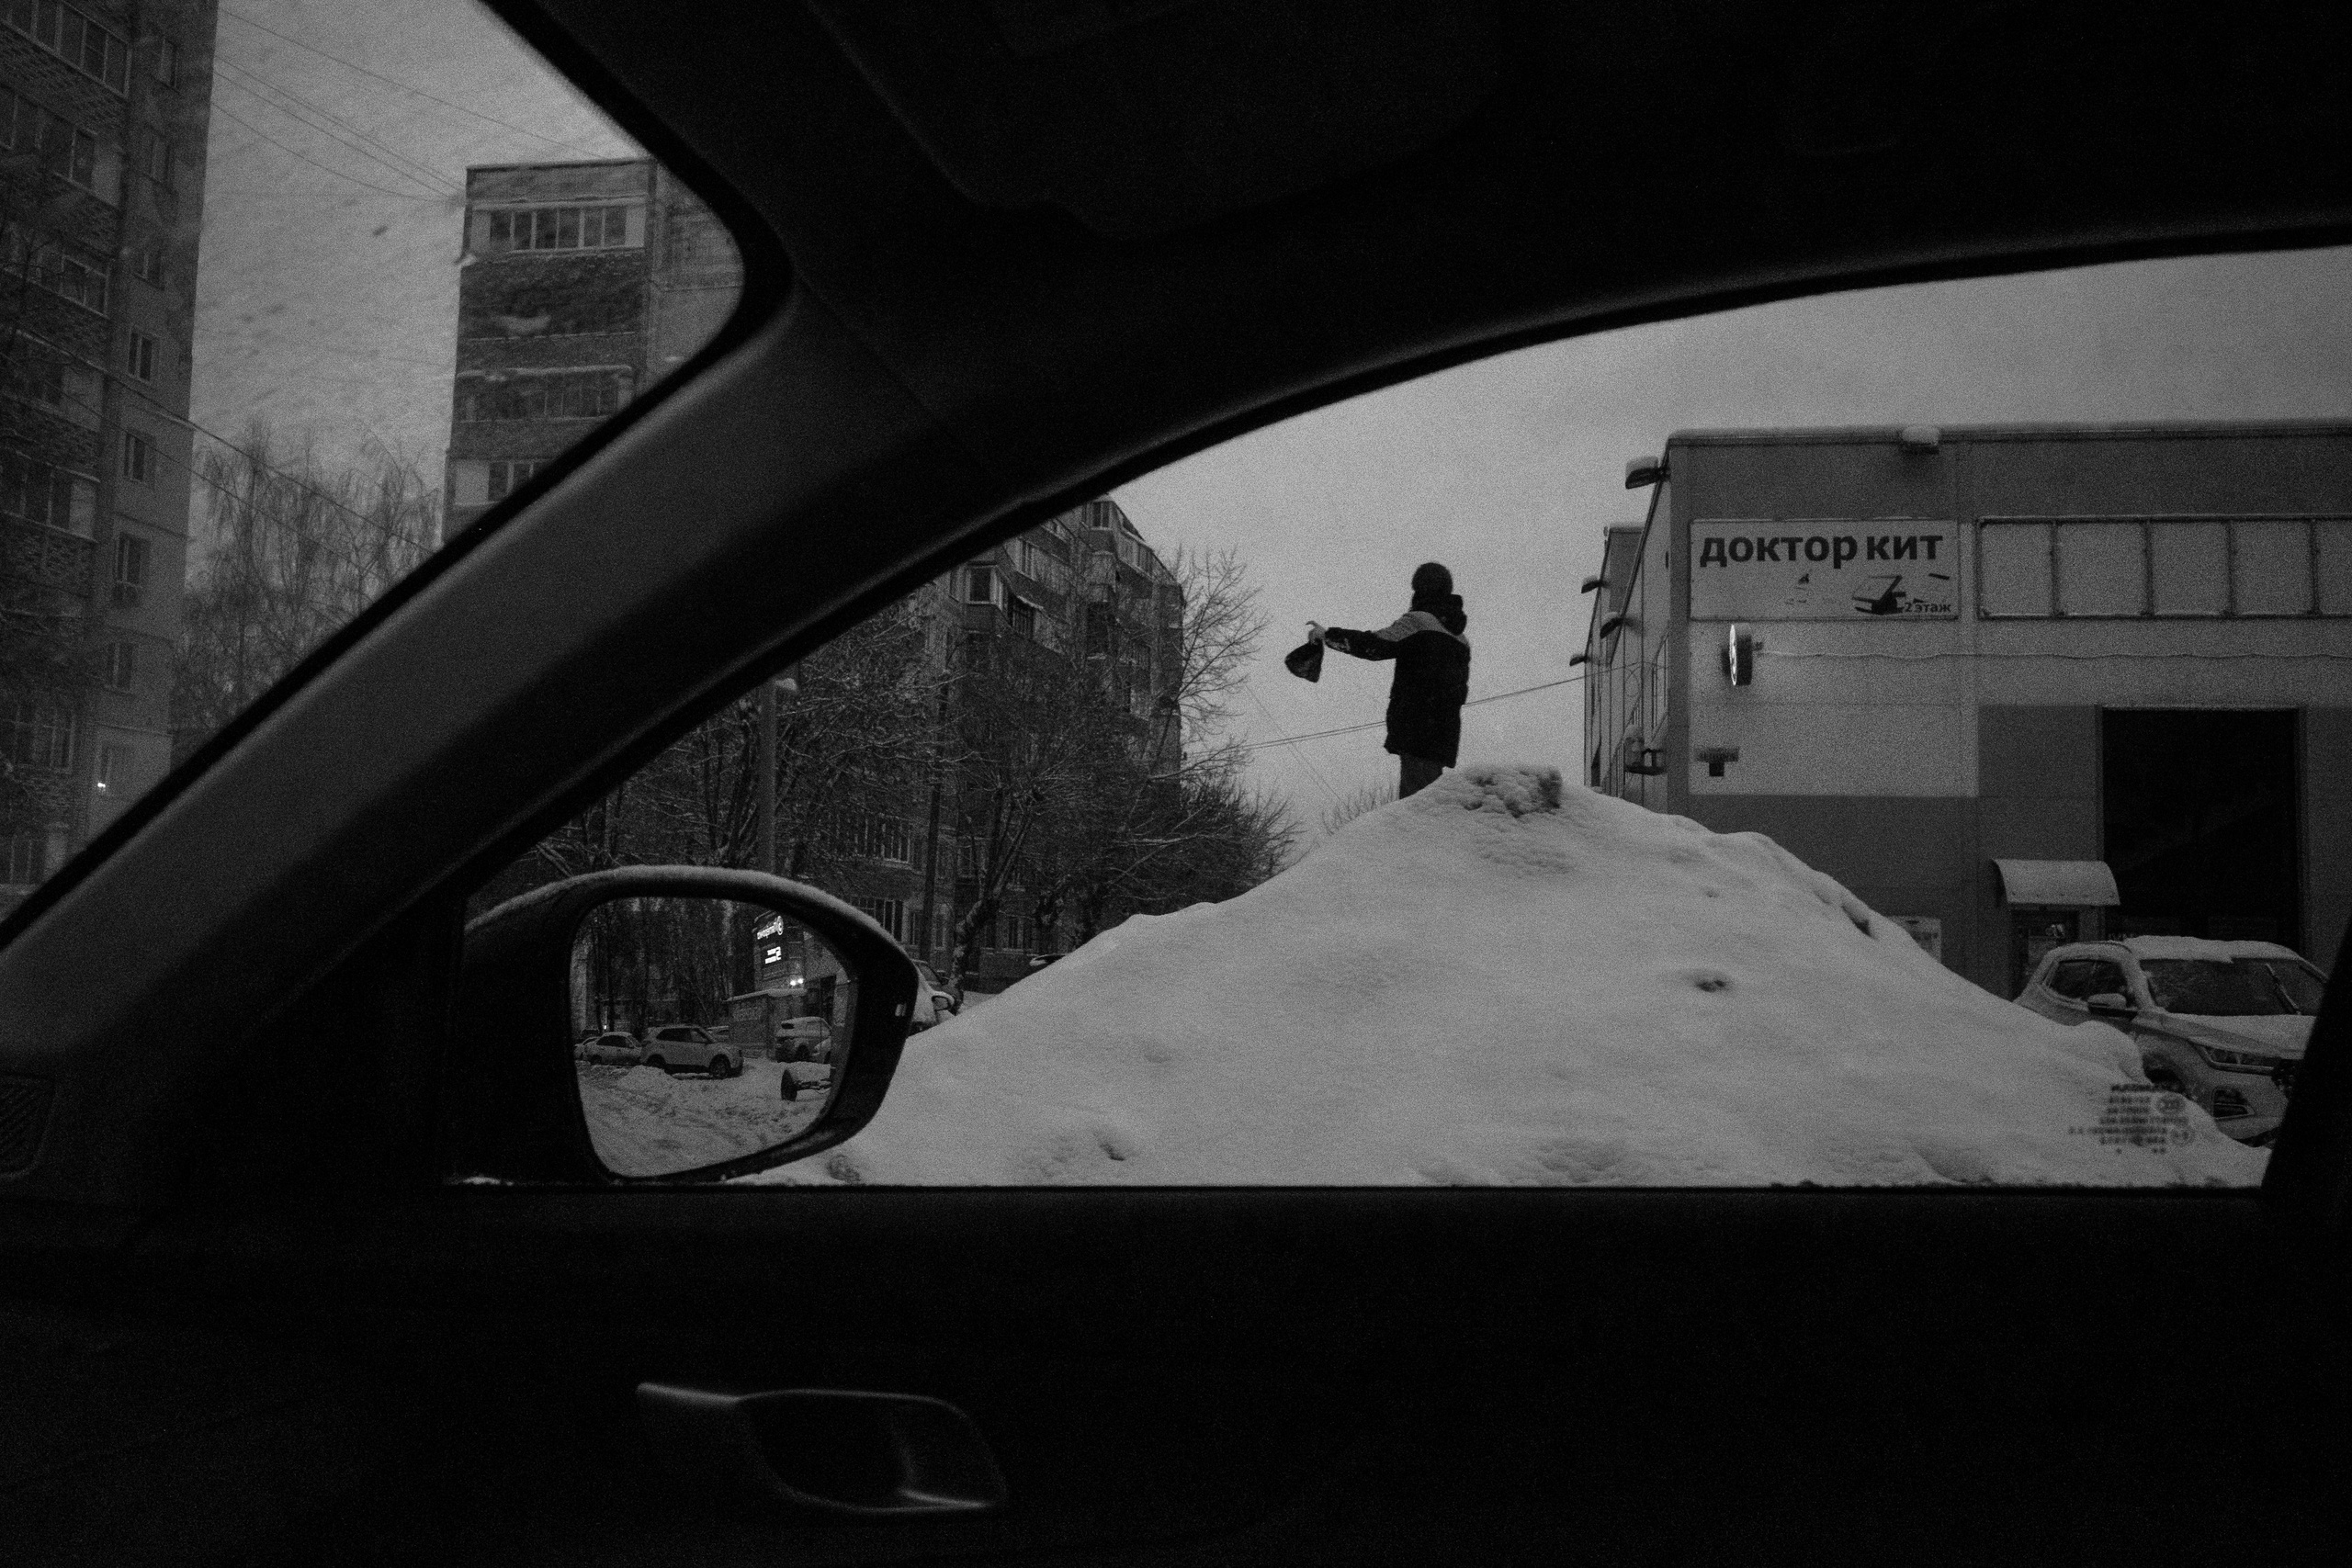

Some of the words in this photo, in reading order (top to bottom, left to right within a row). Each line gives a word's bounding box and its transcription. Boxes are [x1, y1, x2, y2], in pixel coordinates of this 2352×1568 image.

[1700, 535, 1859, 569] доктор
[1867, 535, 1943, 560] кит
[1915, 603, 1952, 613] этаж
